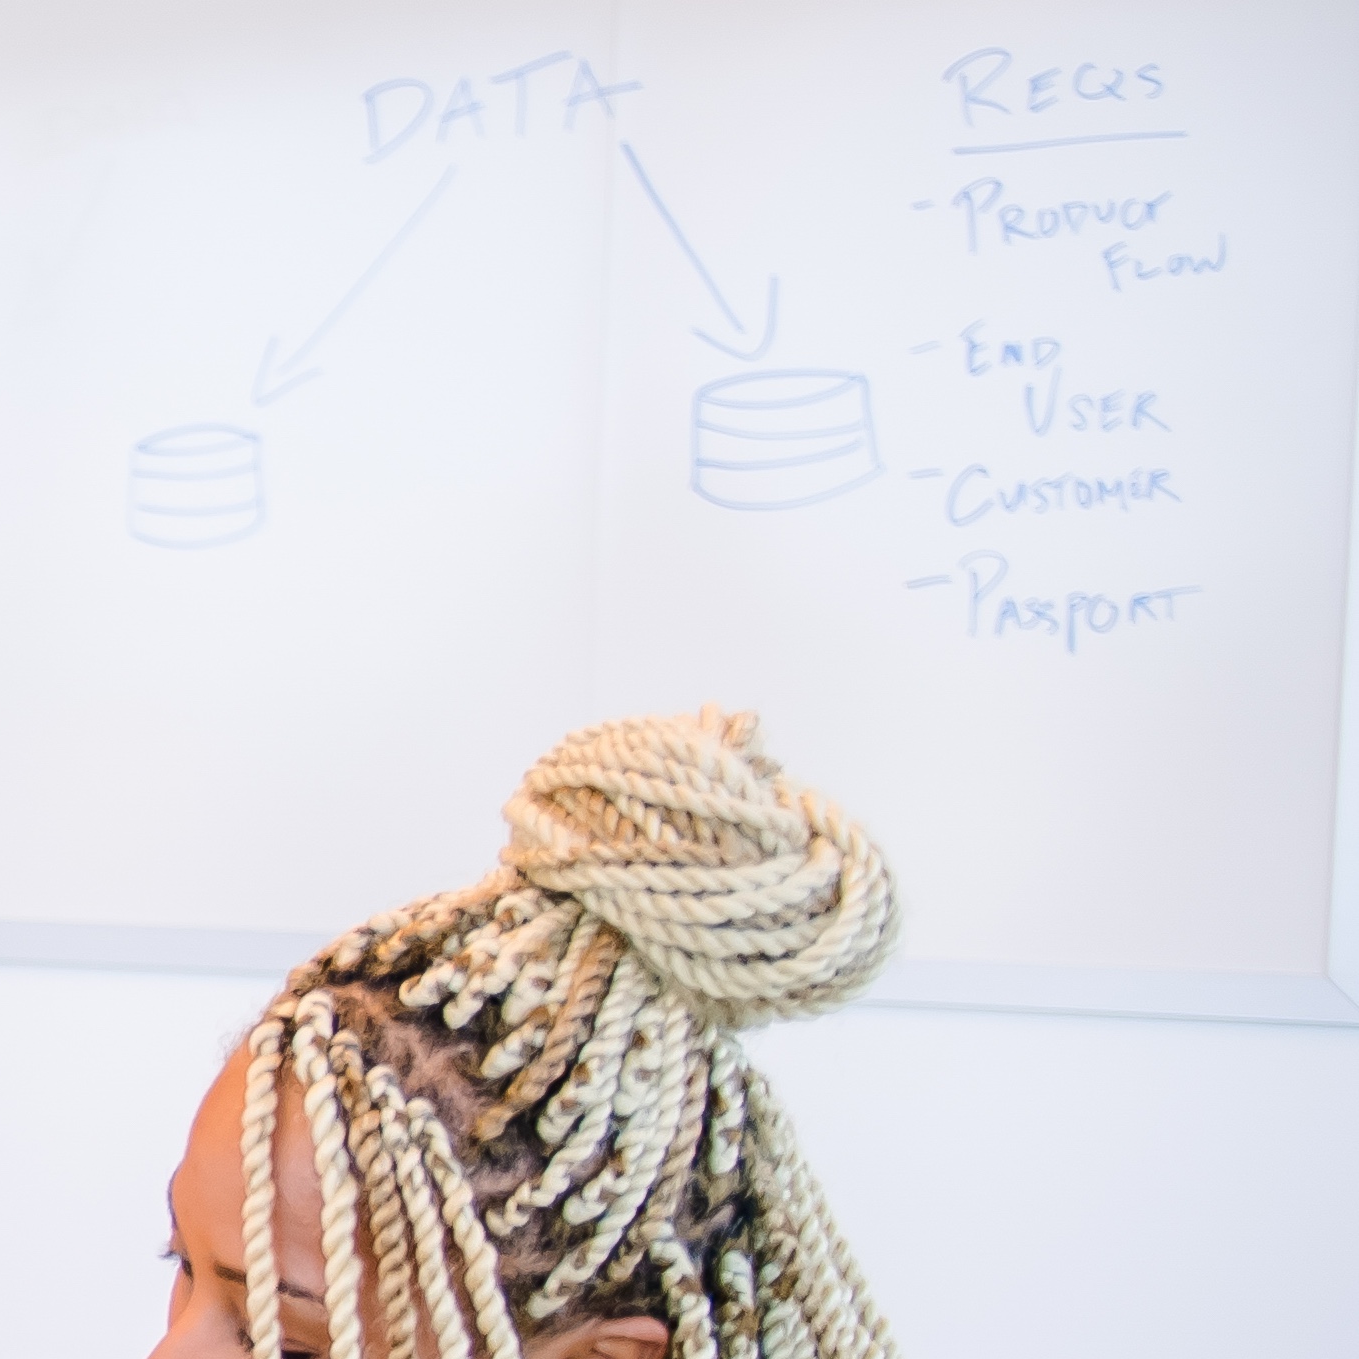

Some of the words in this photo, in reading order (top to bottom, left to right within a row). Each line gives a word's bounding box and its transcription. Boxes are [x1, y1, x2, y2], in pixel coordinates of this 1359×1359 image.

[361, 48, 645, 165] DATA
[942, 46, 1165, 127] REQS
[952, 176, 1173, 254] PRODUCT
[1101, 233, 1228, 292] FLOW
[958, 319, 1062, 376] END
[1024, 365, 1172, 437] USER
[945, 463, 1182, 527] CUSTOMER
[957, 548, 1203, 655] PASSPORT
